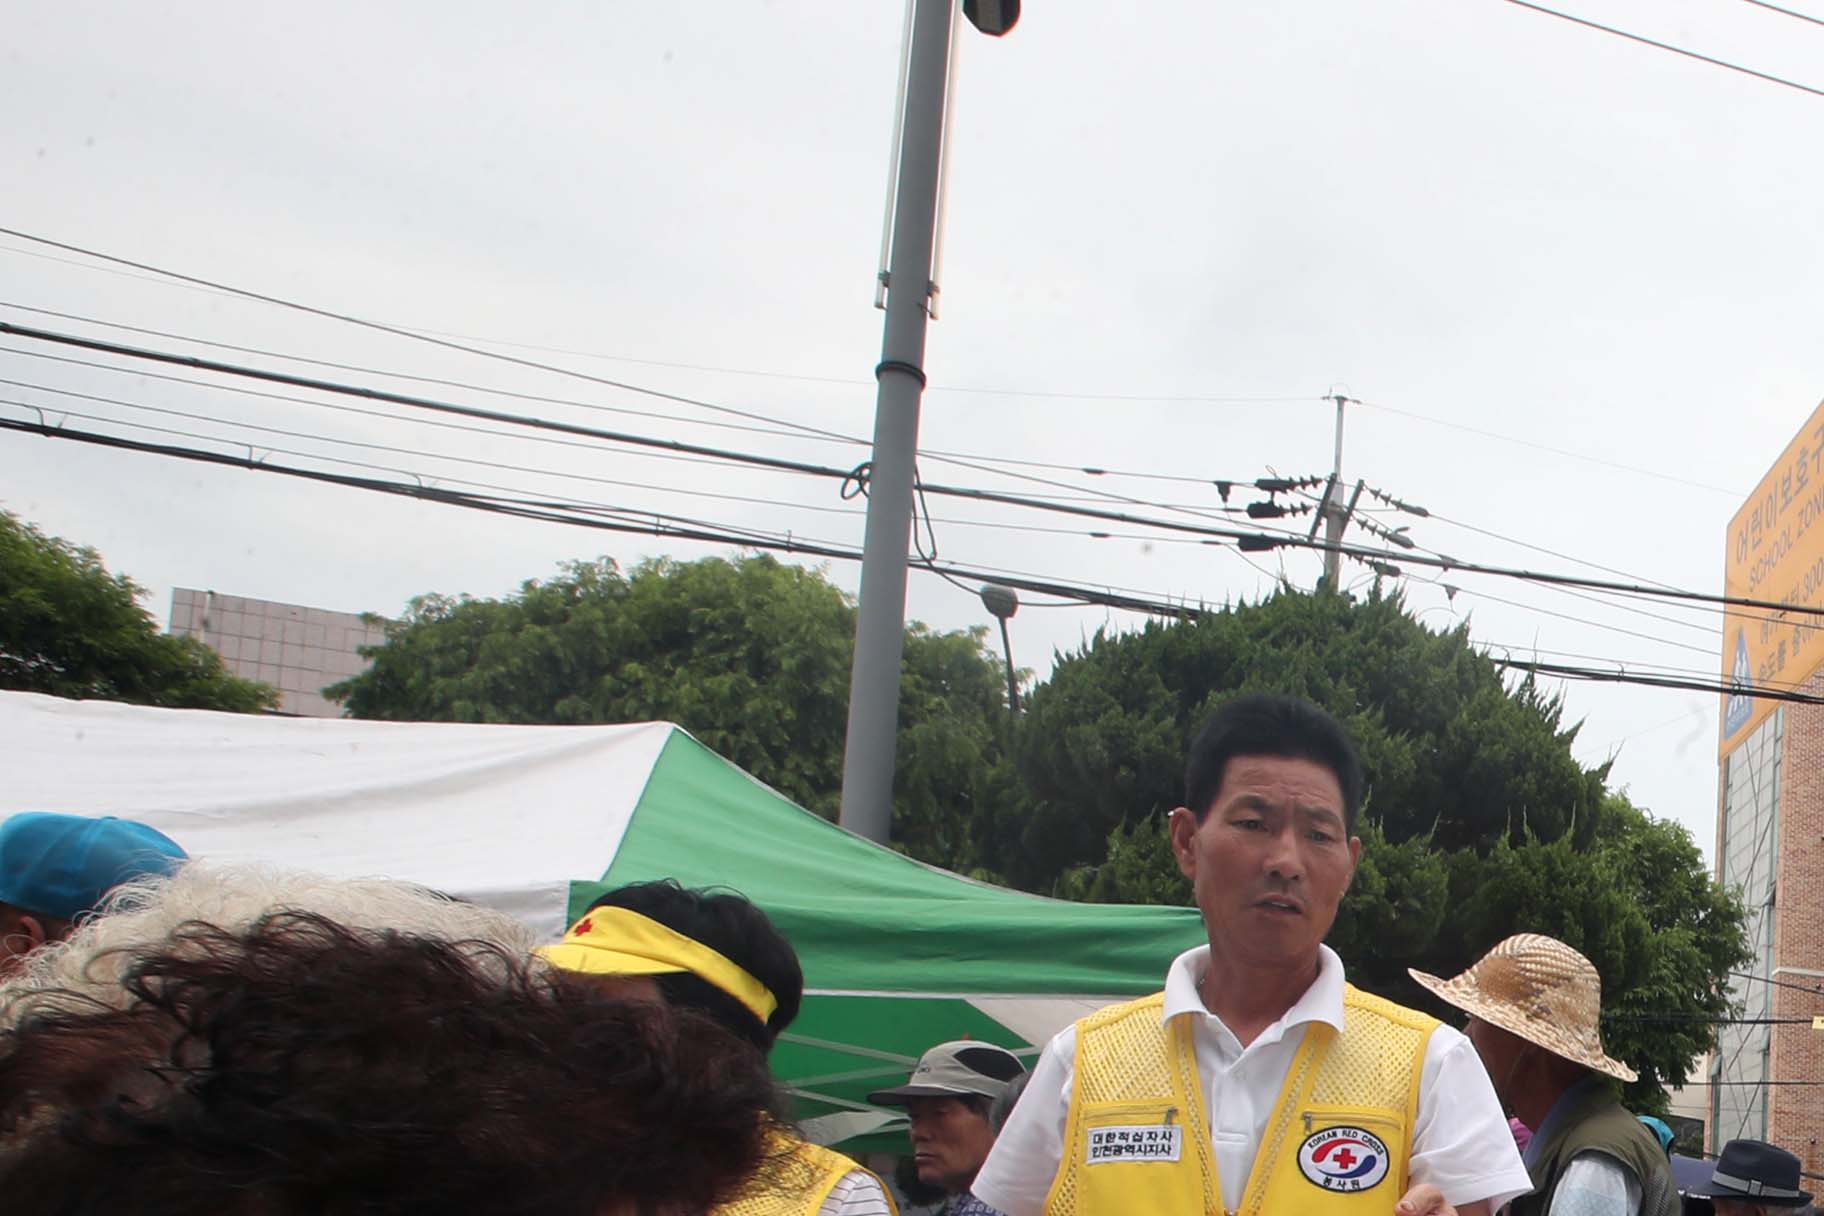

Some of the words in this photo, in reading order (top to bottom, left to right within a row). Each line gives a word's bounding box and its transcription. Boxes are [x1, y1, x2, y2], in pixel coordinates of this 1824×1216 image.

[1749, 525, 1793, 593] SCHOOL
[1093, 1131, 1172, 1145] 대한적십자사
[1308, 1131, 1338, 1149] KOREAN
[1342, 1130, 1358, 1139] RED
[1362, 1135, 1384, 1156] CROSS
[1092, 1144, 1171, 1158] 인천광역시지사
